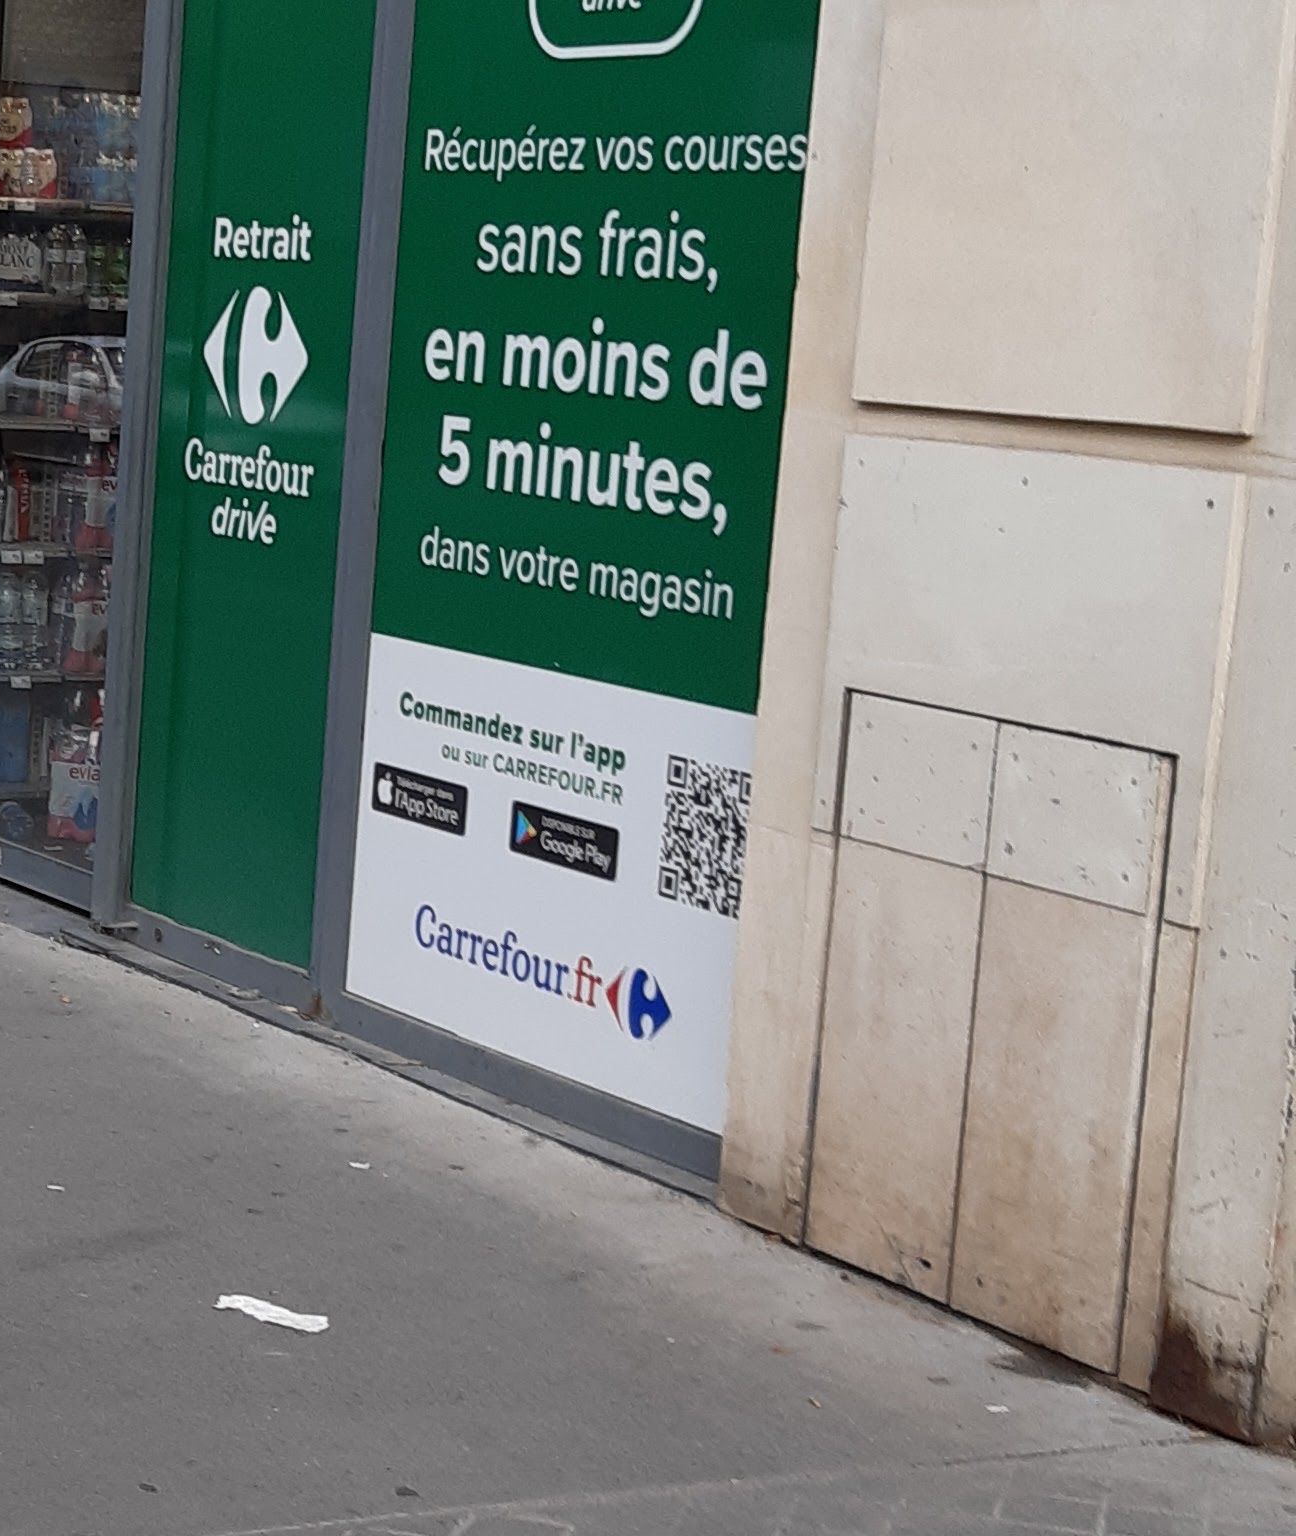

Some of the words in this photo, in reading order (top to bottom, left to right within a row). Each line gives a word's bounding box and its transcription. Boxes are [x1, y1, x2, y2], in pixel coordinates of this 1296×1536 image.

[424, 125, 585, 182] Récupérez
[595, 132, 654, 171] vos
[664, 131, 809, 172] courses
[214, 214, 312, 262] Retrait
[476, 220, 583, 276] sans
[599, 209, 719, 293] frais,
[424, 328, 486, 384] en
[502, 316, 670, 402] moins
[688, 328, 768, 411] de
[184, 437, 315, 497] Carrefour
[438, 414, 471, 487] 5
[486, 421, 729, 537] minutes,
[211, 497, 278, 544] drive
[420, 526, 491, 576] dans
[499, 545, 580, 592] votre
[589, 560, 734, 620] magasin
[399, 691, 524, 745] Commandez
[529, 728, 565, 755] sur
[570, 730, 627, 776] l'app
[68, 765, 102, 782] evia
[441, 743, 461, 762] ou
[465, 748, 490, 768] sur
[493, 753, 624, 806] CARREFOUR.FR
[425, 797, 460, 826] Store
[540, 830, 585, 863] Google
[585, 842, 613, 874] Play
[415, 904, 602, 1007] Carrefour.fr
